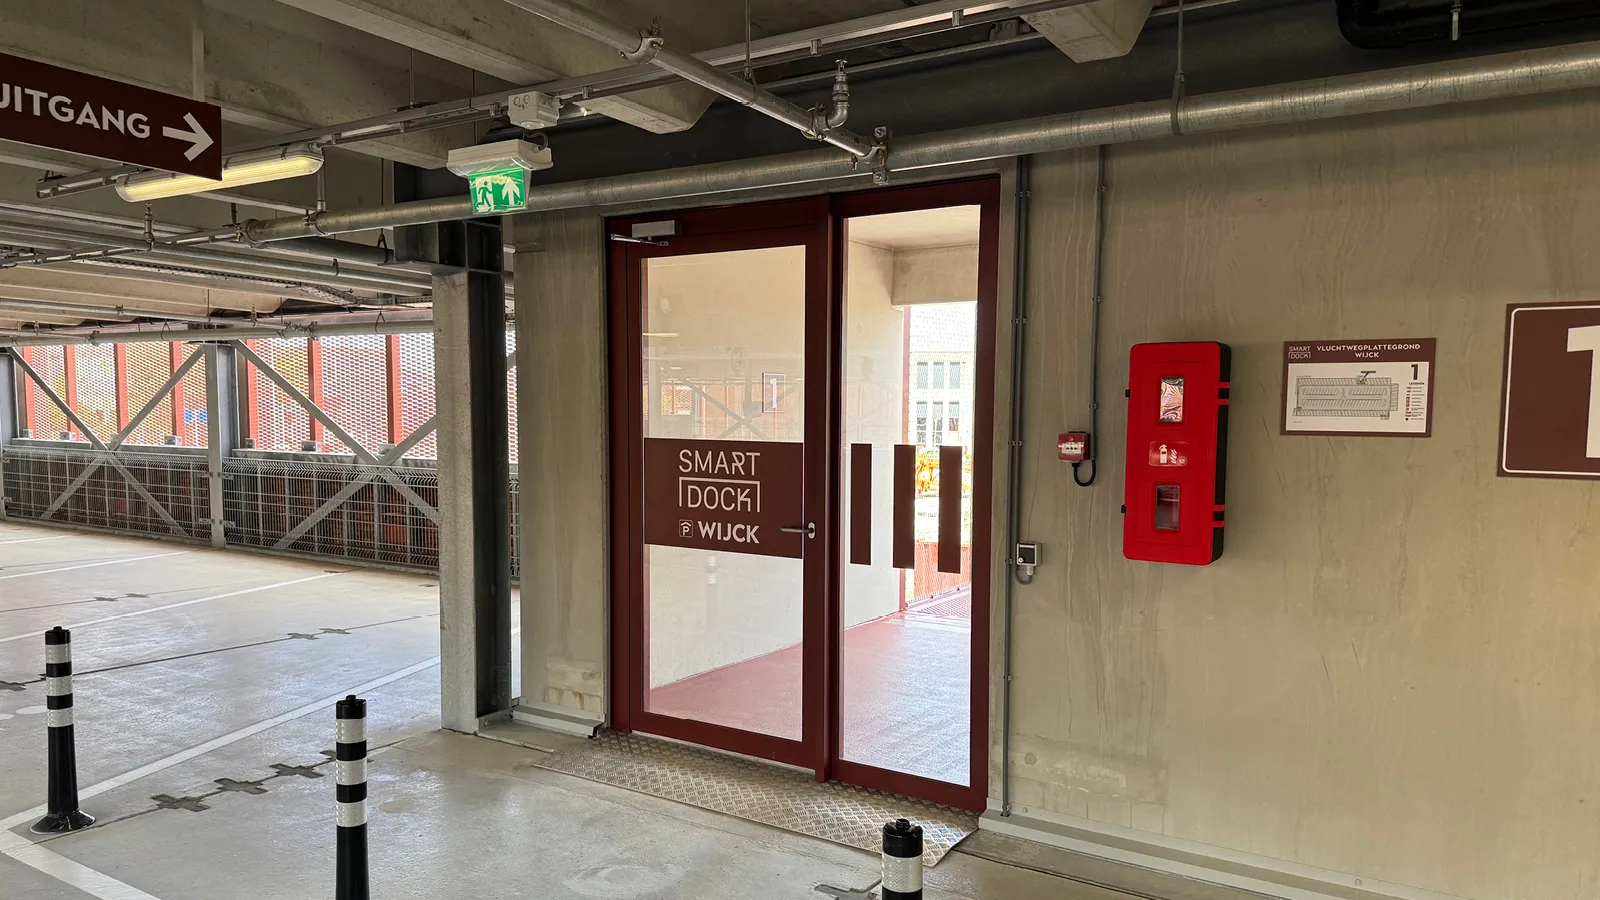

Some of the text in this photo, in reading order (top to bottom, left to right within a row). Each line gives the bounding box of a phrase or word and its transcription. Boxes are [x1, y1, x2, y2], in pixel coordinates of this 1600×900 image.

[1316, 343, 1421, 352] VLUCHTWEGPLATTEGROND
[1411, 364, 1418, 380] 1
[679, 449, 760, 476] SMART
[687, 485, 751, 512] DOCK
[697, 521, 760, 544] WIJCK
